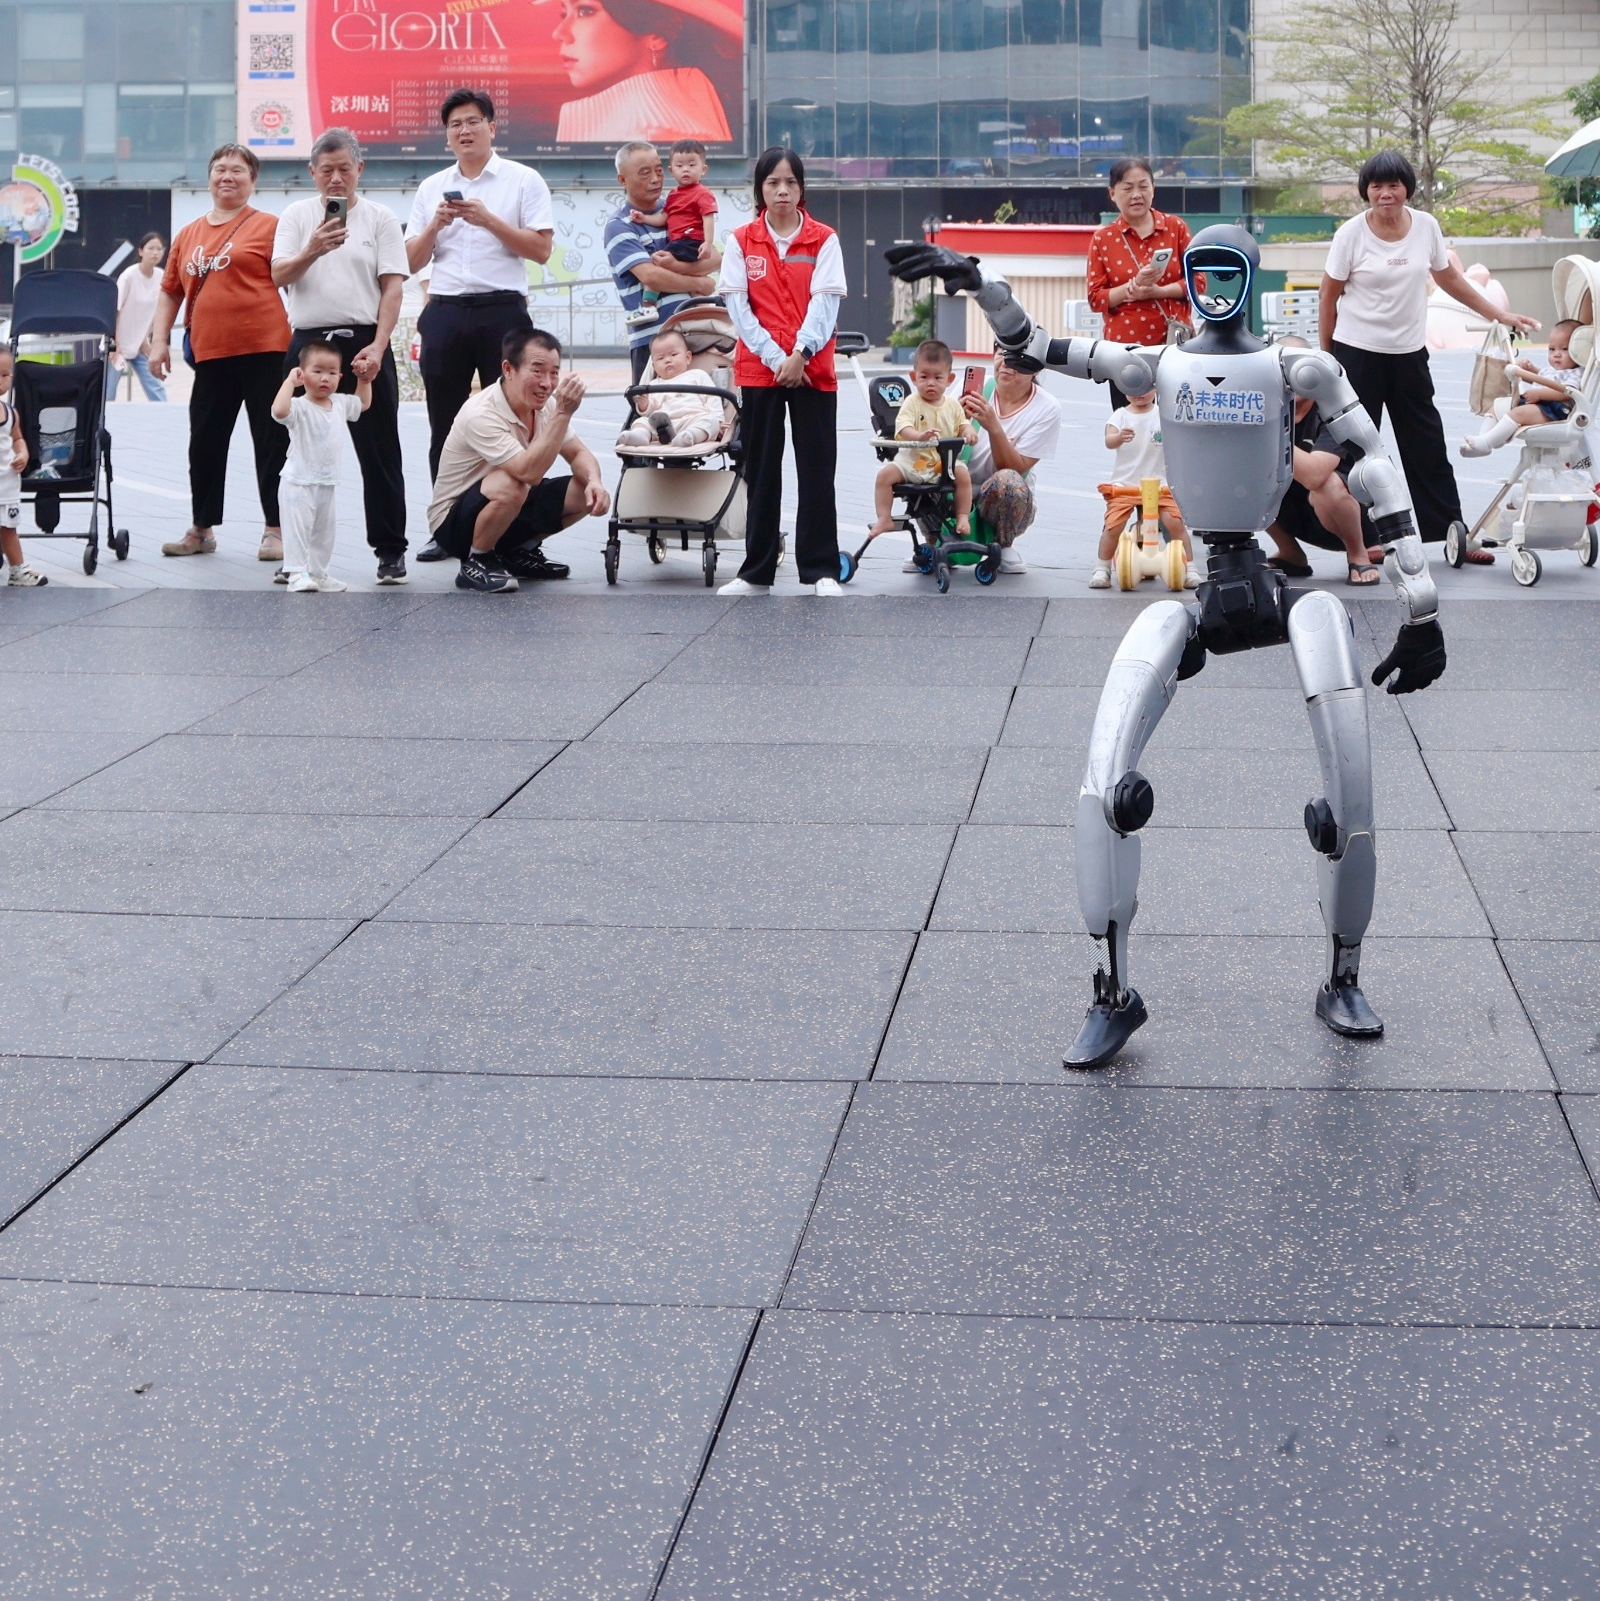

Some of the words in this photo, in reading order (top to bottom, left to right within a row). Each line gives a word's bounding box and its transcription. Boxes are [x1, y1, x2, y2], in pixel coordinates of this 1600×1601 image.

[331, 11, 507, 52] GLORIA
[331, 95, 390, 114] 深圳站
[1195, 391, 1264, 410] 未来时代
[1196, 409, 1238, 422] Future
[1243, 411, 1264, 423] Era
